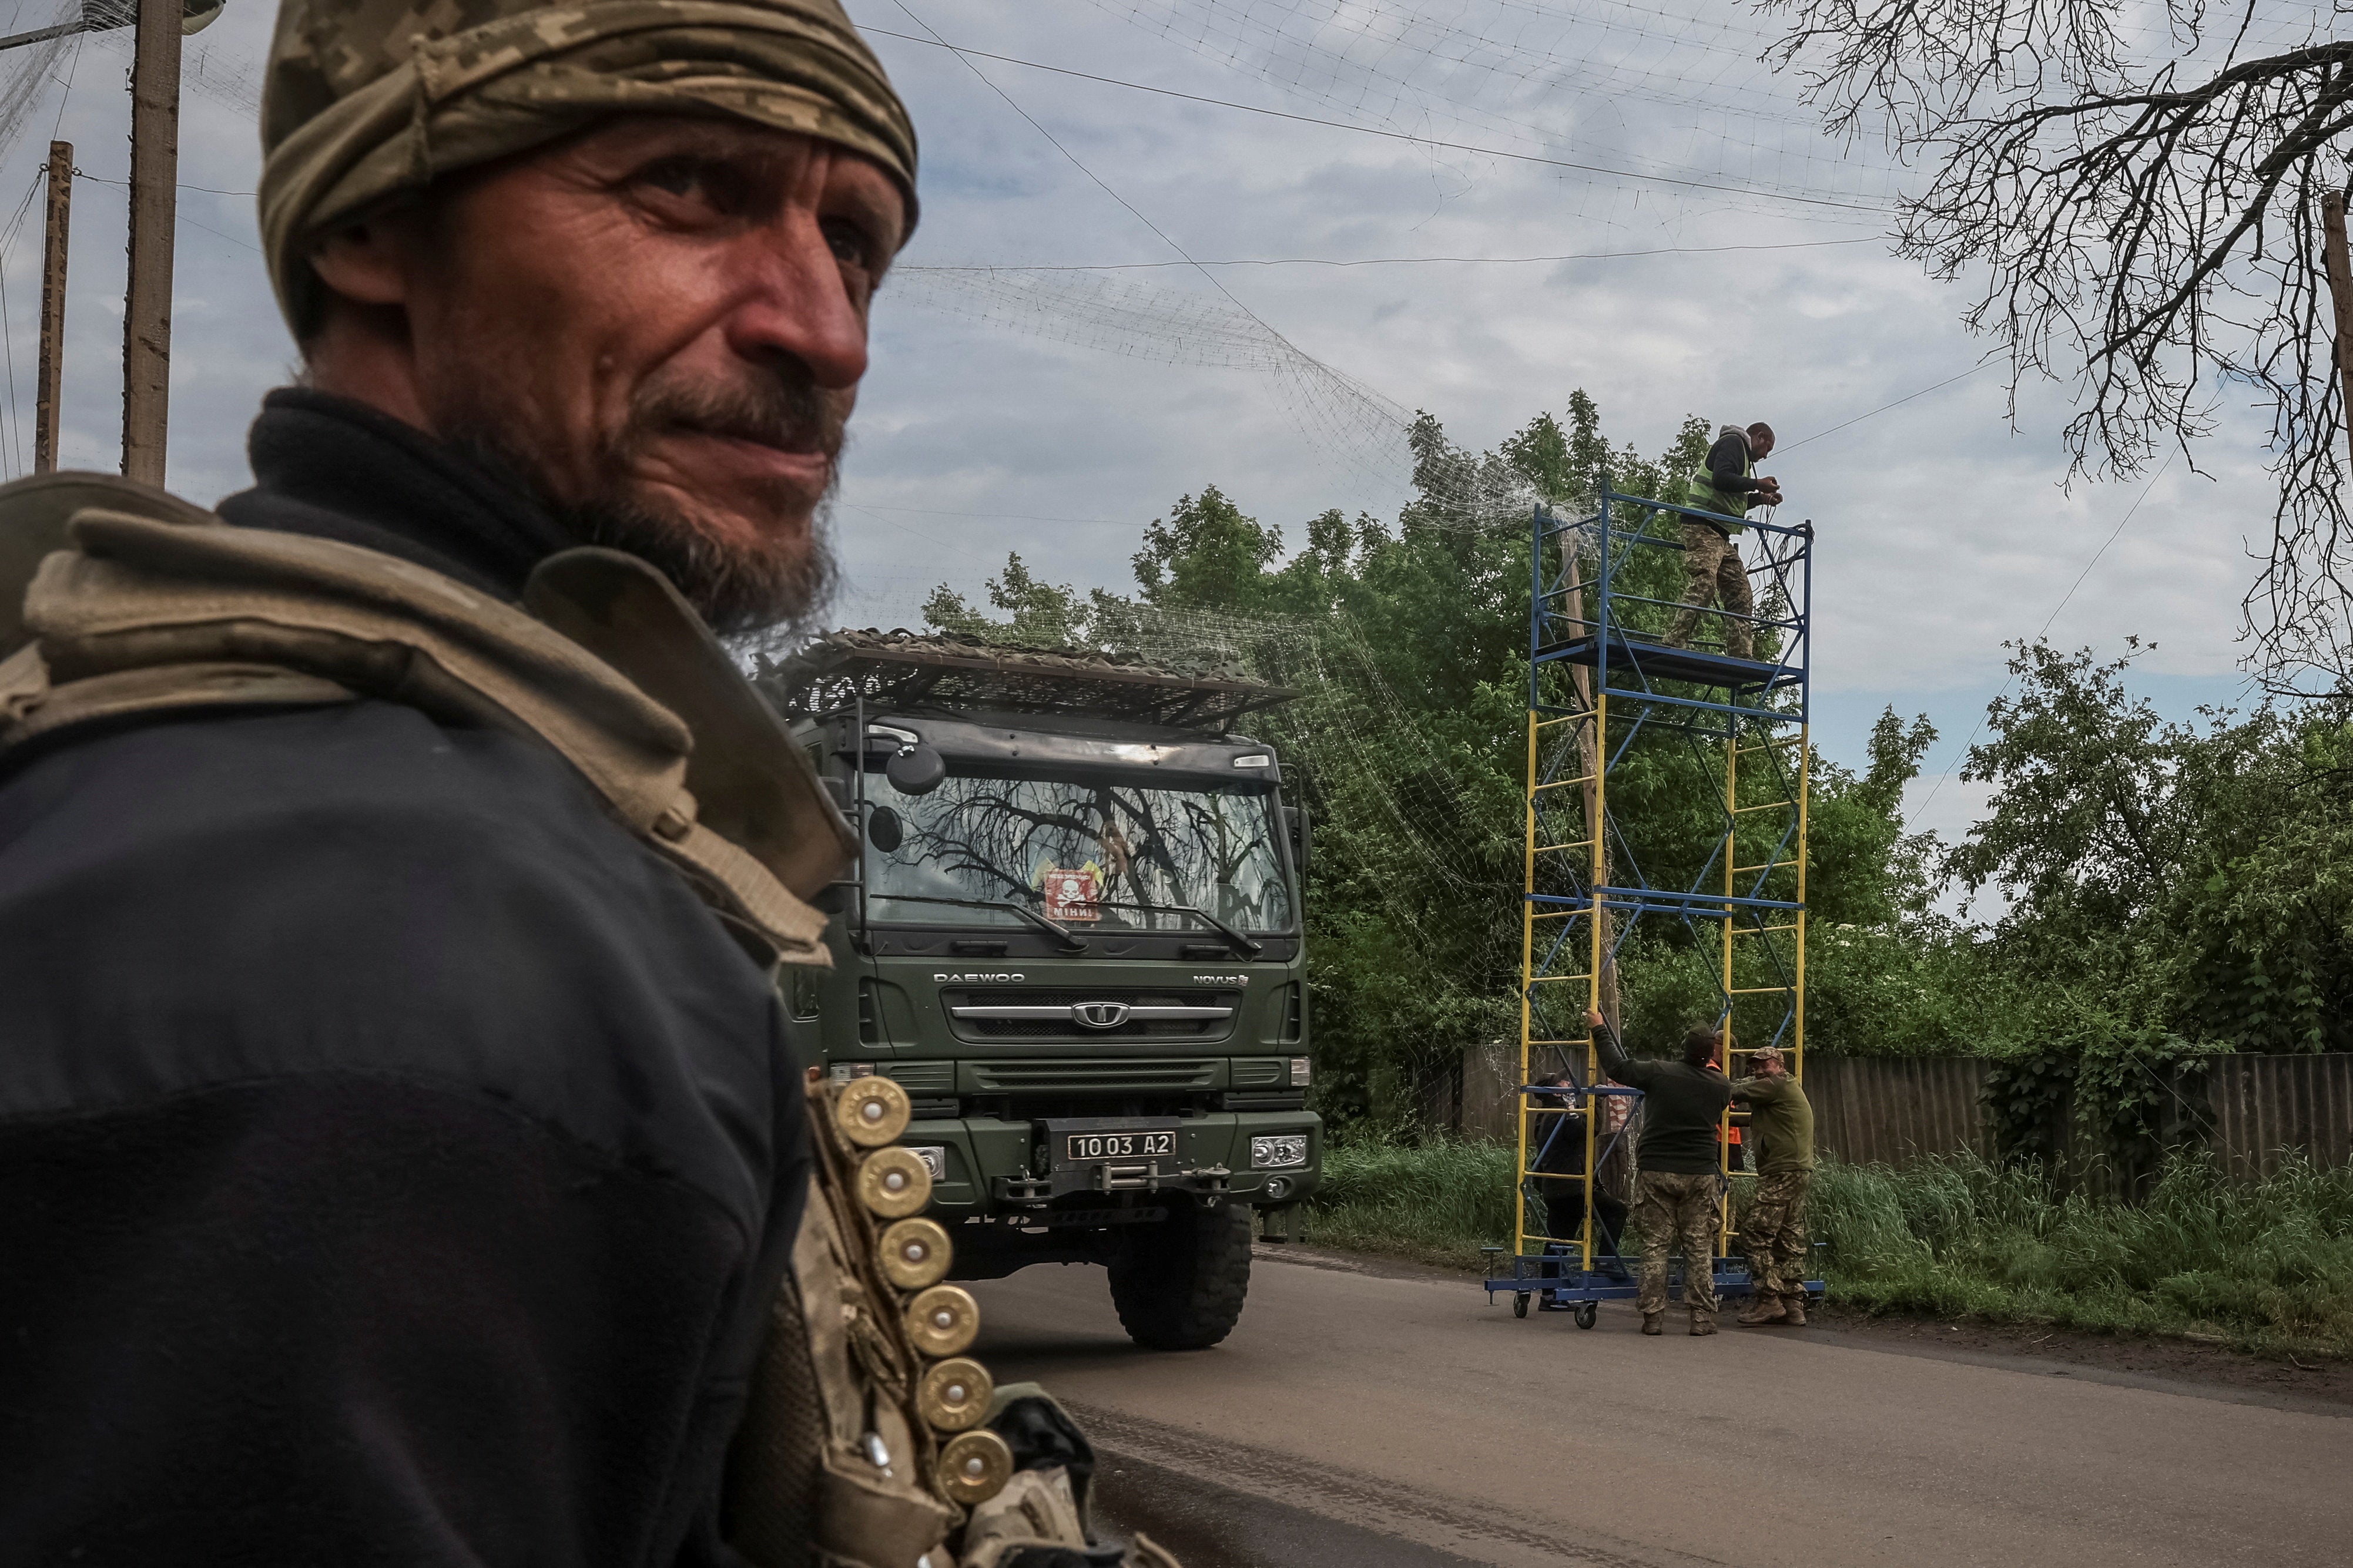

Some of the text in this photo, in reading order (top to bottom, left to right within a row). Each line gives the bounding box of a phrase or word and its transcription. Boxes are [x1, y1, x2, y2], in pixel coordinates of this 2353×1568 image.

[933, 973, 1025, 982] DAEWOO
[1193, 975, 1237, 984] NOVUS
[1144, 1135, 1169, 1154] A2
